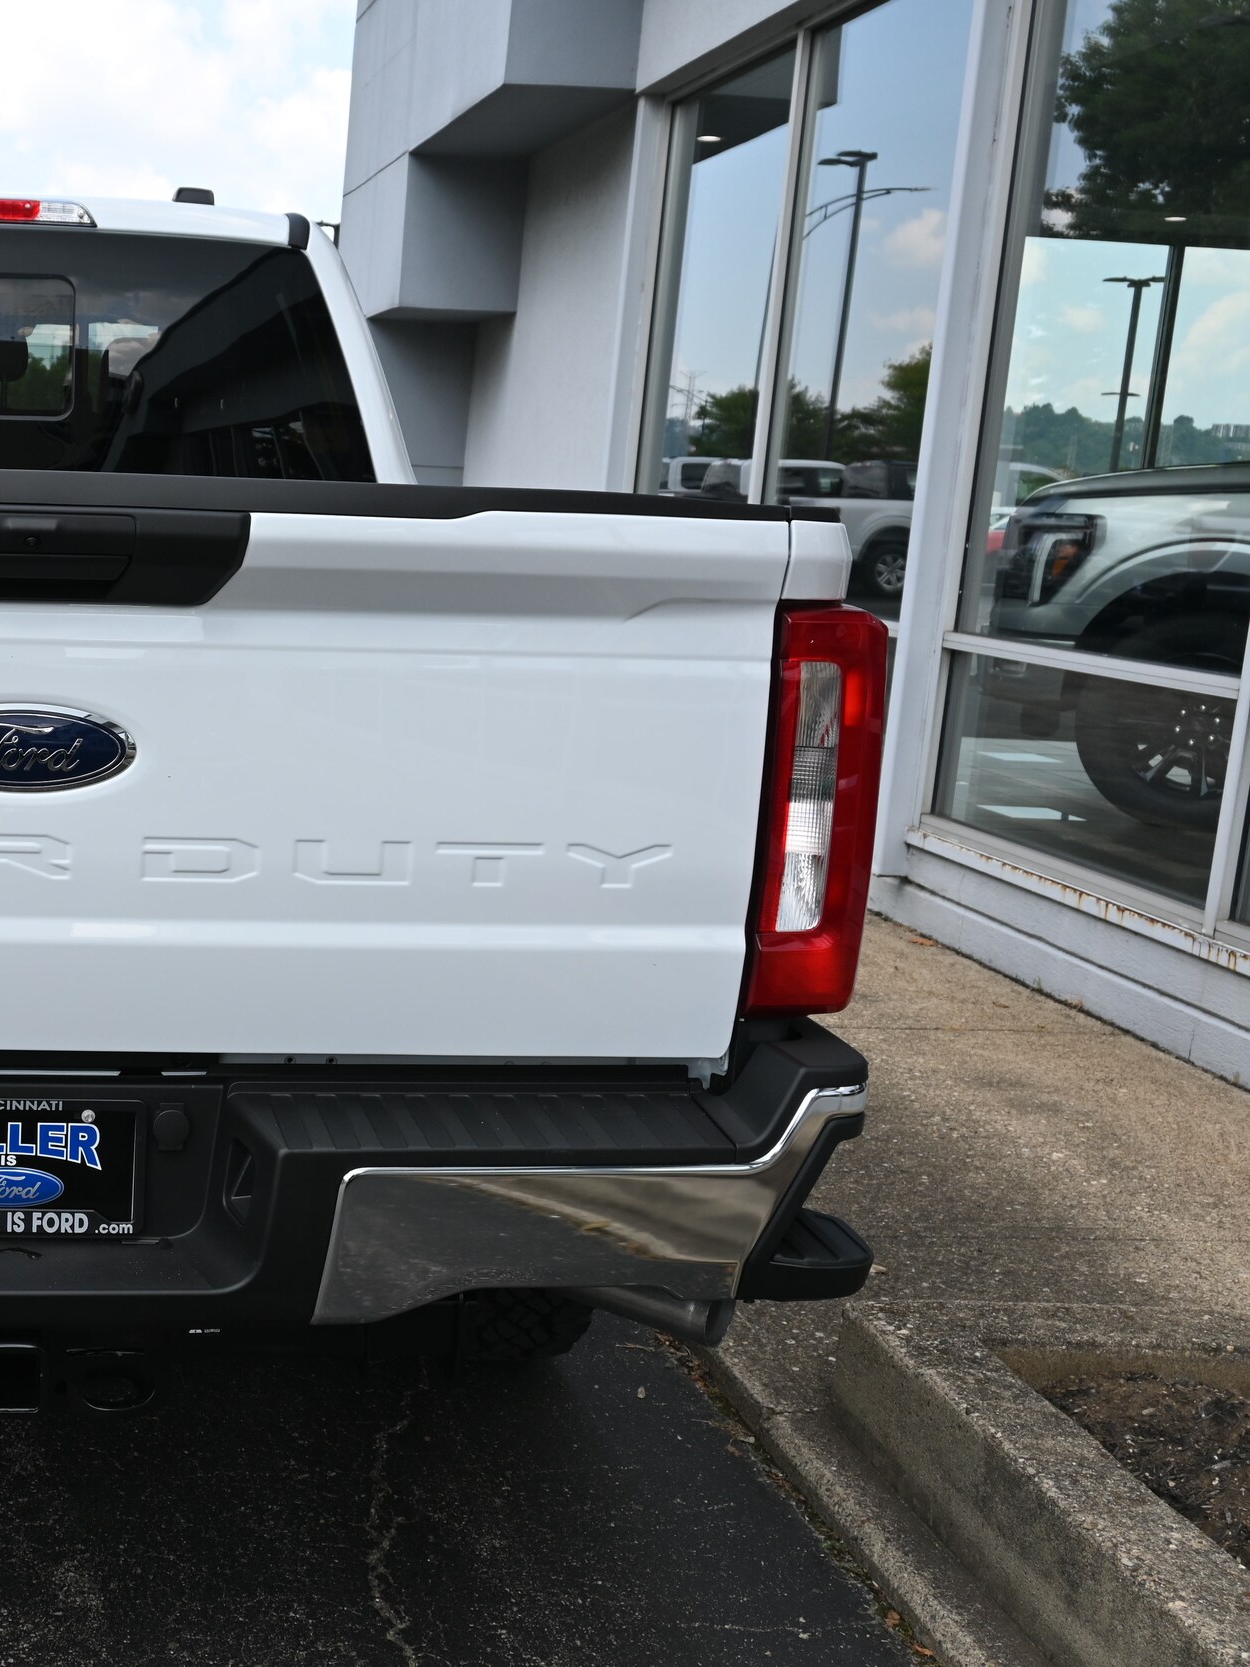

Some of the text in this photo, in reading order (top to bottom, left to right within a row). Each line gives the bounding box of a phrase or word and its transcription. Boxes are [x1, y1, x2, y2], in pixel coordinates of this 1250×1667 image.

[141, 835, 674, 888] DUTY
[0, 1155, 17, 1166] IS
[7, 1211, 25, 1233] IS
[32, 1212, 89, 1234] FORD
[95, 1222, 134, 1234] .com
